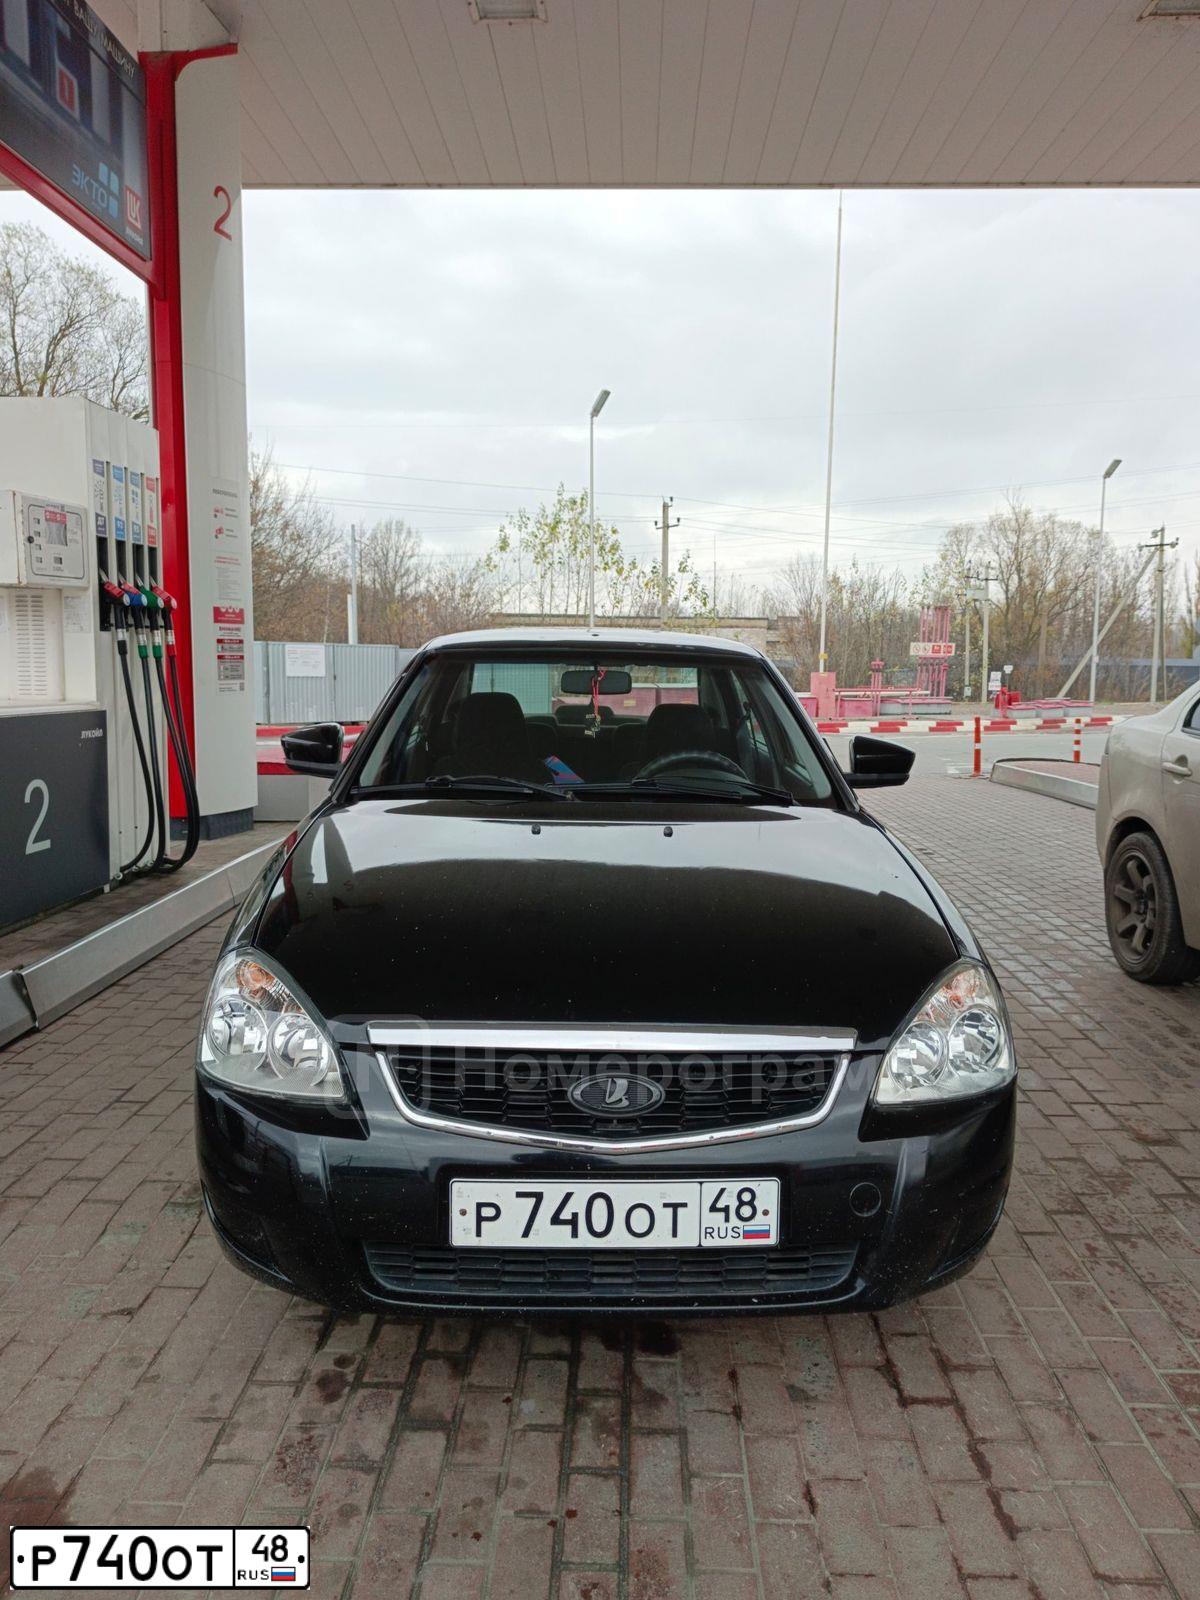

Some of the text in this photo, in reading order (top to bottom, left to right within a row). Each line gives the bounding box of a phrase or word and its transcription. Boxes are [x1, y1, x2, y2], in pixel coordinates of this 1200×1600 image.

[213, 185, 233, 241] 2
[24, 779, 52, 856] 2
[708, 1187, 758, 1223] 48
[704, 1227, 742, 1240] RUS
